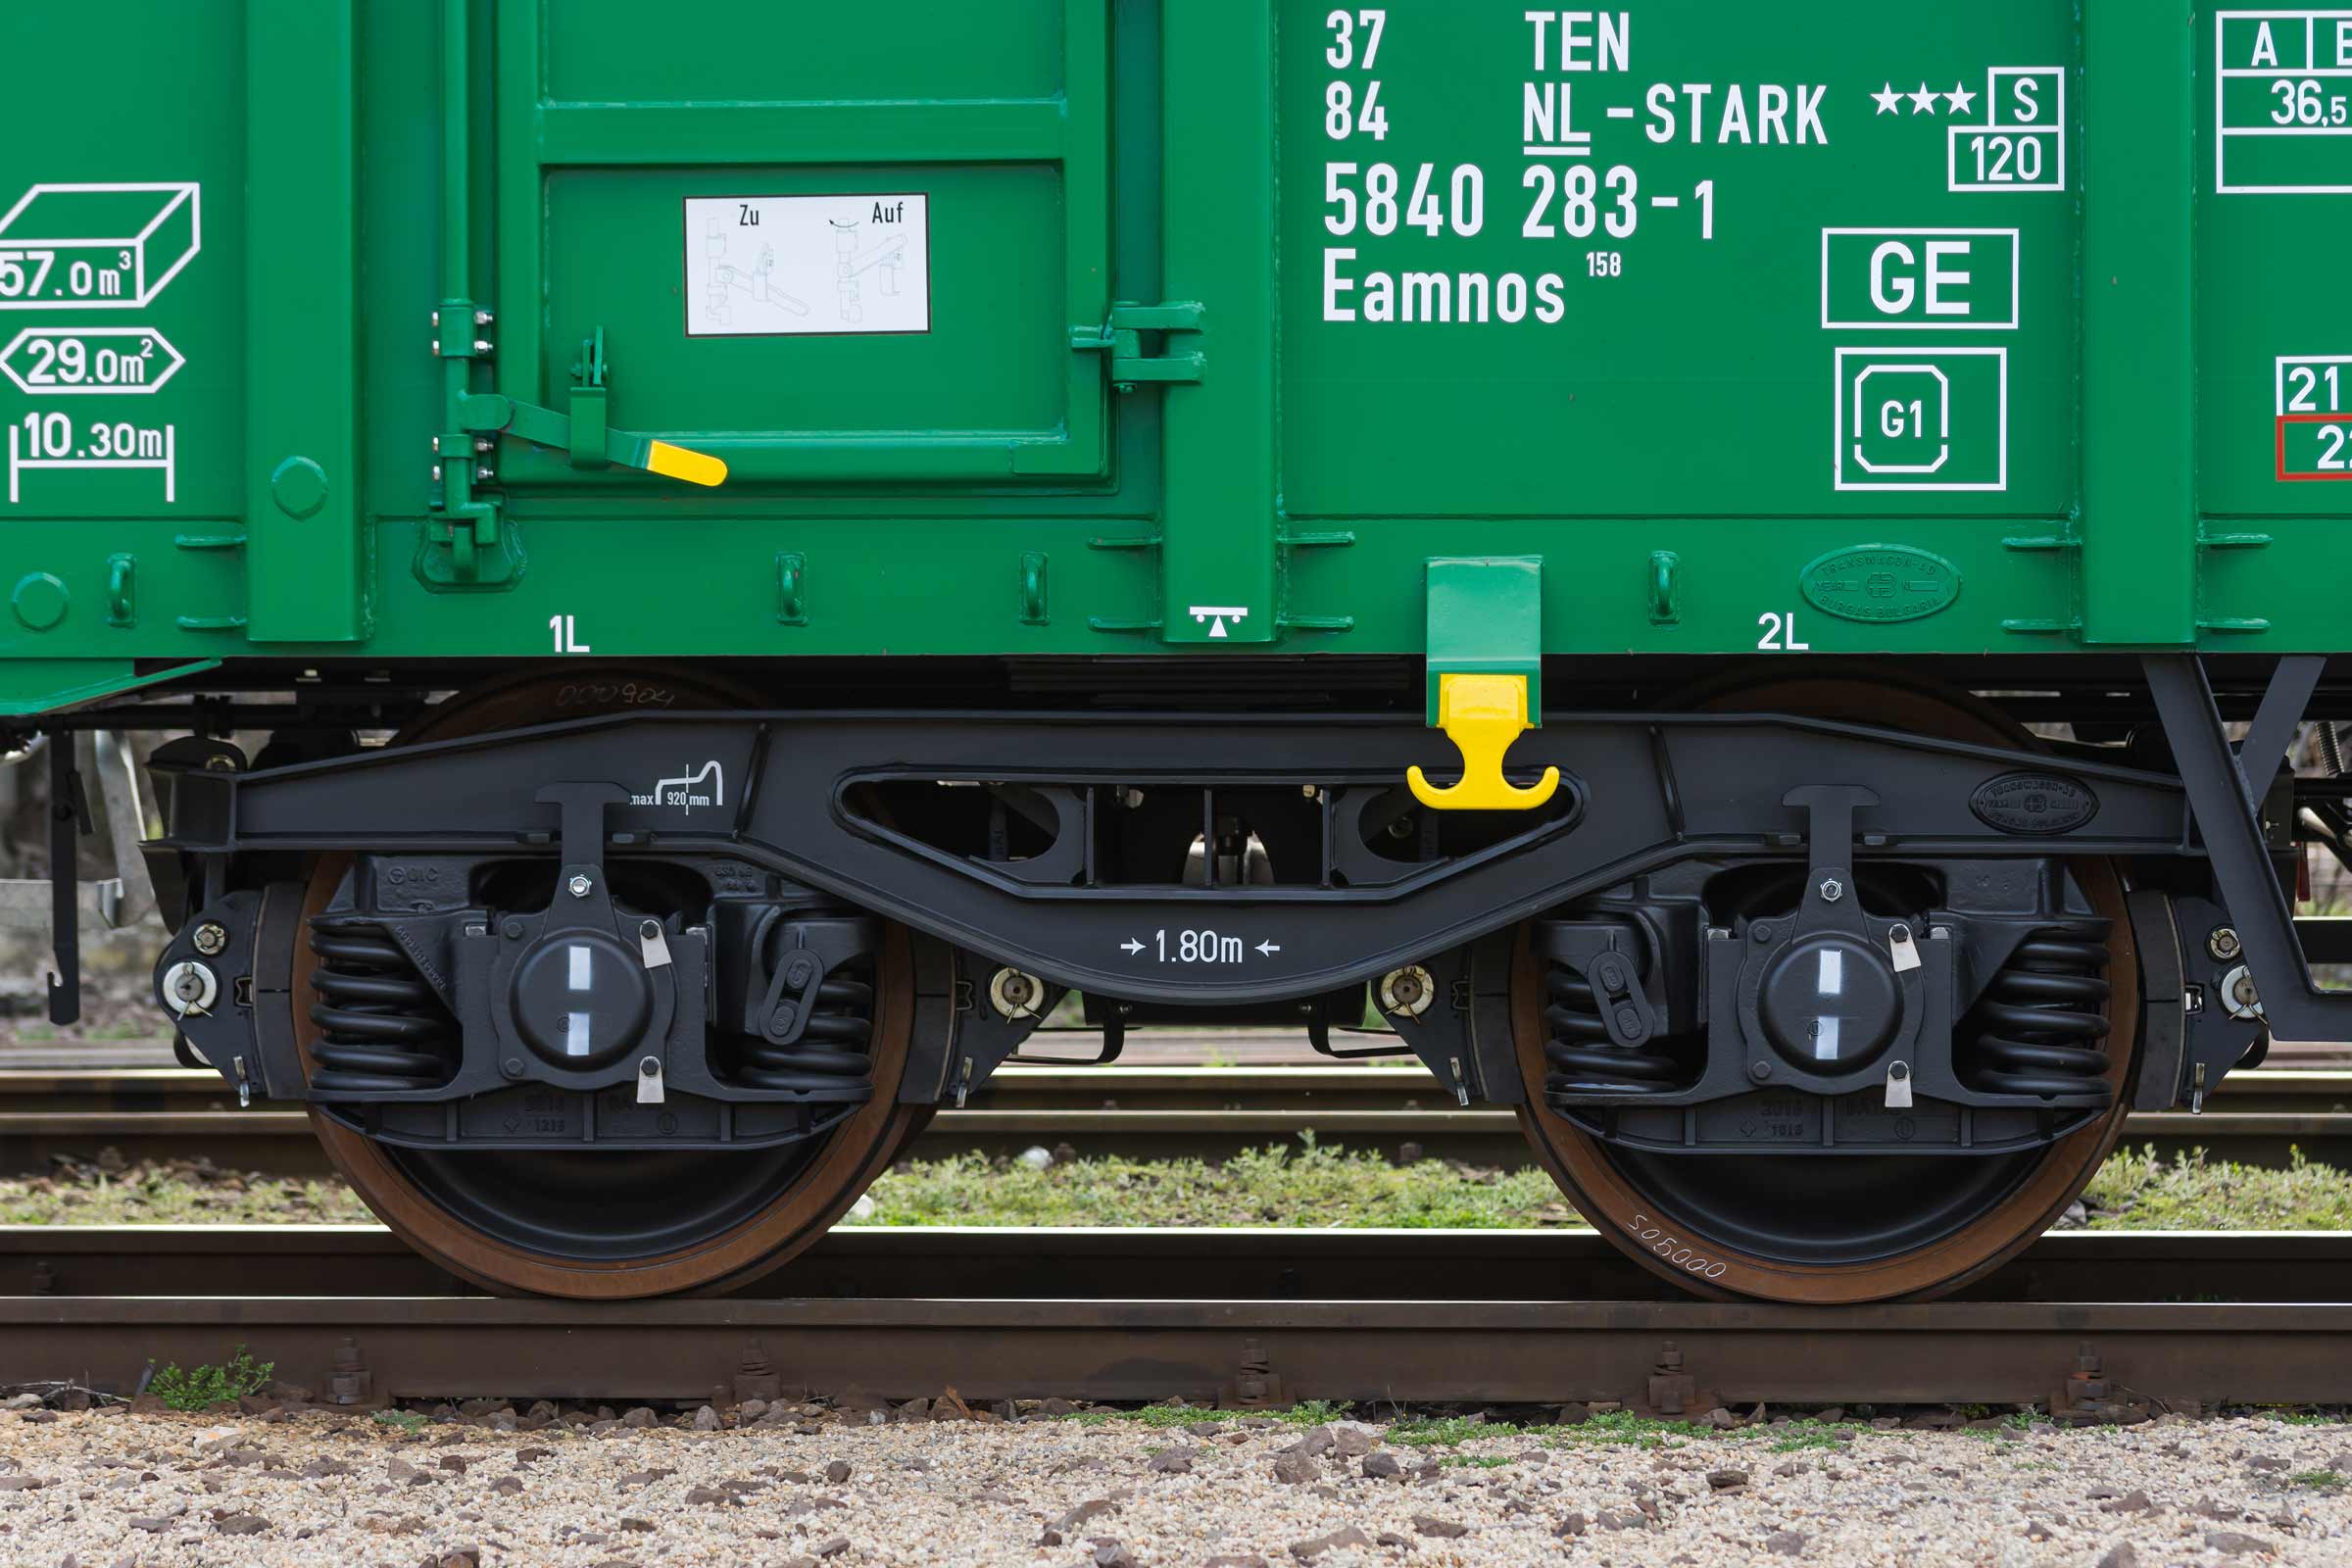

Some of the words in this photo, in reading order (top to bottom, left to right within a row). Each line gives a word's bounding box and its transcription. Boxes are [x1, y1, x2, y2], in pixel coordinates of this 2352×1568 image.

[1326, 9, 1386, 70] 37
[1525, 12, 1630, 72] TEN
[2251, 21, 2278, 67] A
[1326, 80, 1388, 141] 84
[2014, 77, 2038, 122] S
[1971, 136, 2041, 180] 120
[740, 204, 760, 225] Zu
[872, 201, 904, 223] Auf
[1324, 163, 1483, 236] 5840
[1323, 248, 1565, 324] Eamnos
[1586, 252, 1622, 276] 158
[1870, 241, 1971, 315] GE
[2288, 367, 2337, 411] 21
[1881, 401, 1922, 437] G1
[550, 614, 591, 653] 1L
[1757, 612, 1809, 651] 2L
[666, 791, 687, 806] 920
[689, 796, 710, 806] mm
[1155, 930, 1243, 962] 1.80m
